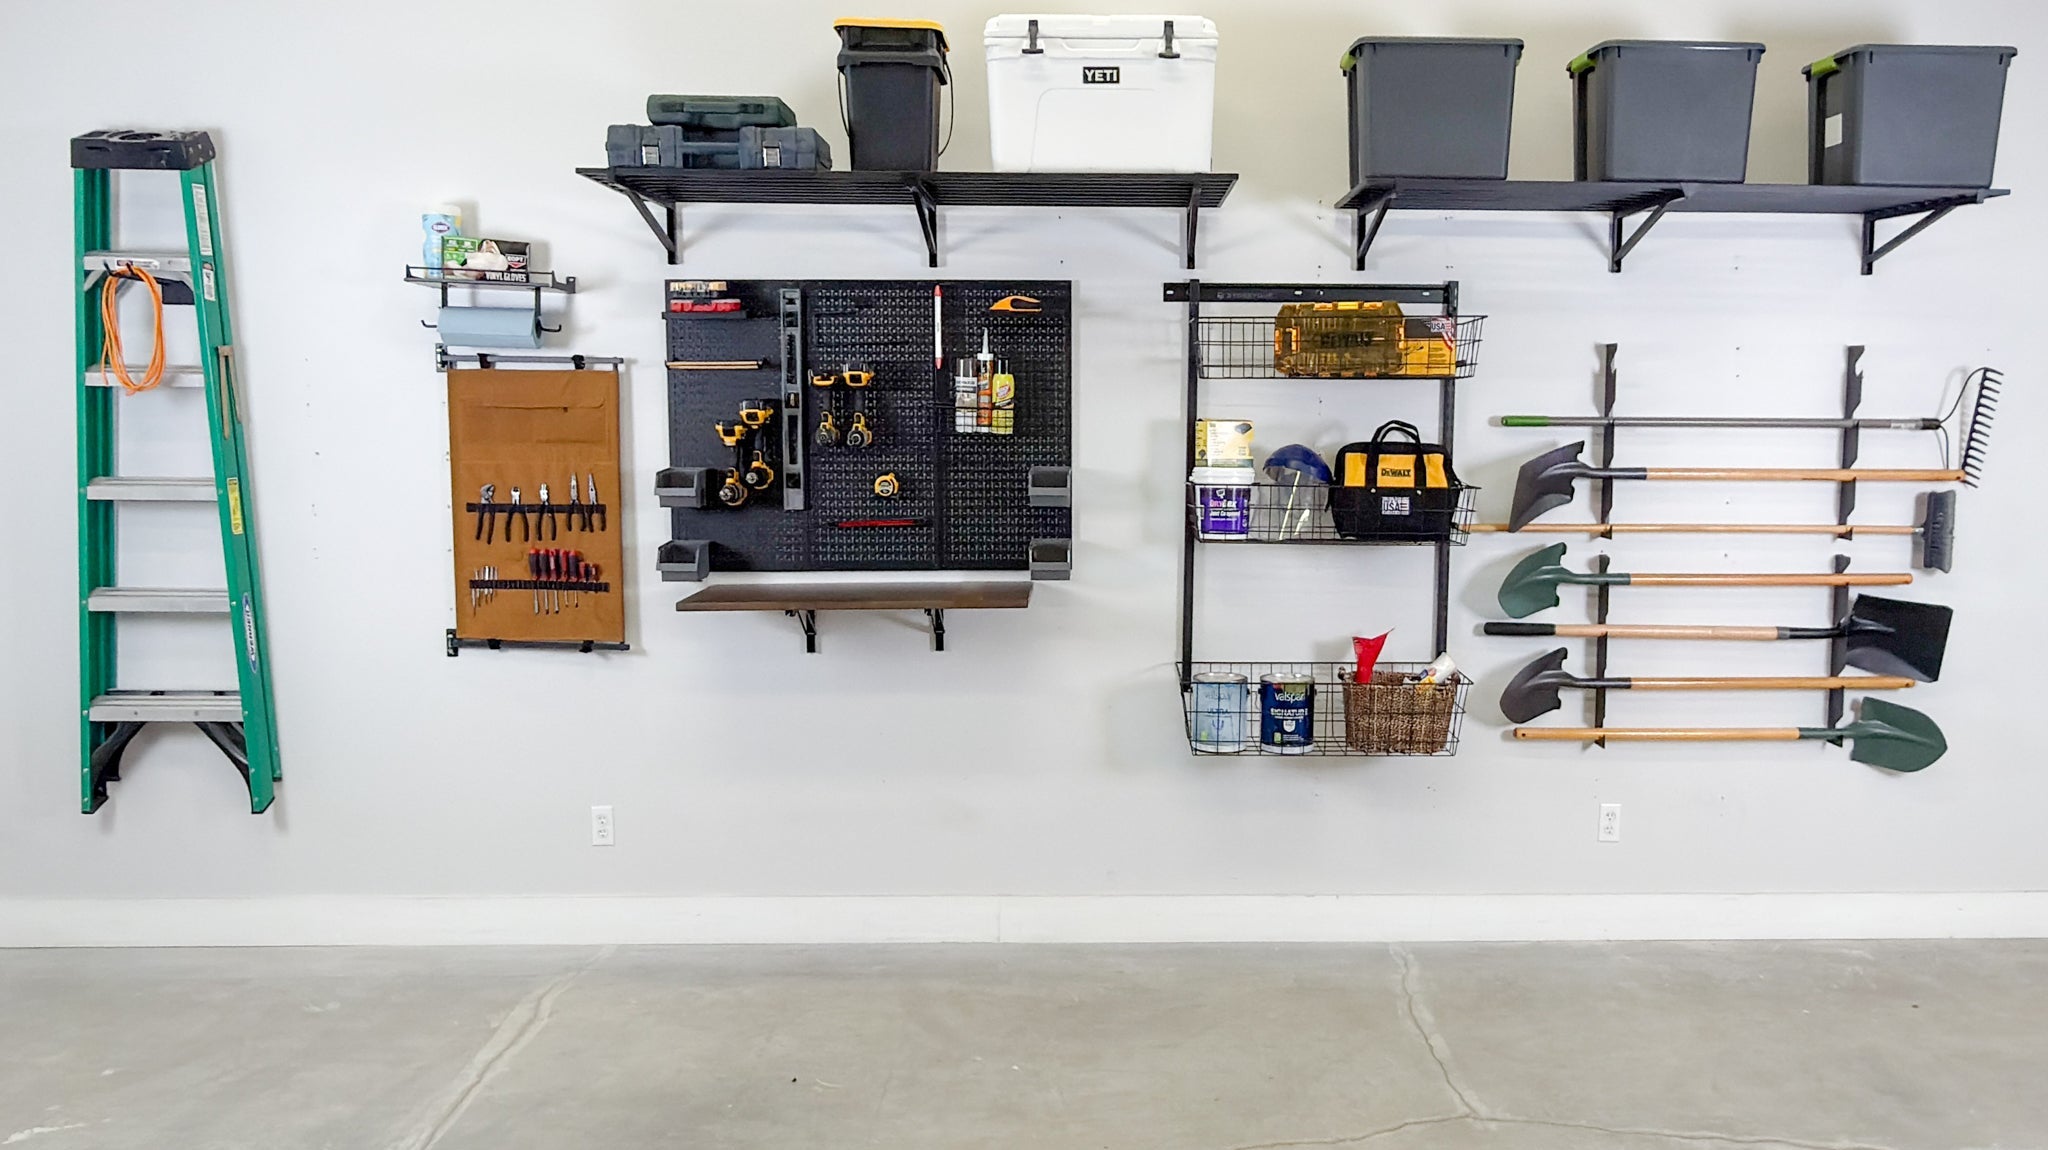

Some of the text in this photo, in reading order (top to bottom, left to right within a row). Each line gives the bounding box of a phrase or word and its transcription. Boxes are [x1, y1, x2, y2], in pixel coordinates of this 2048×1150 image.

[1084, 69, 1118, 82] YETI
[1431, 322, 1446, 331] USA
[1384, 502, 1400, 512] USA
